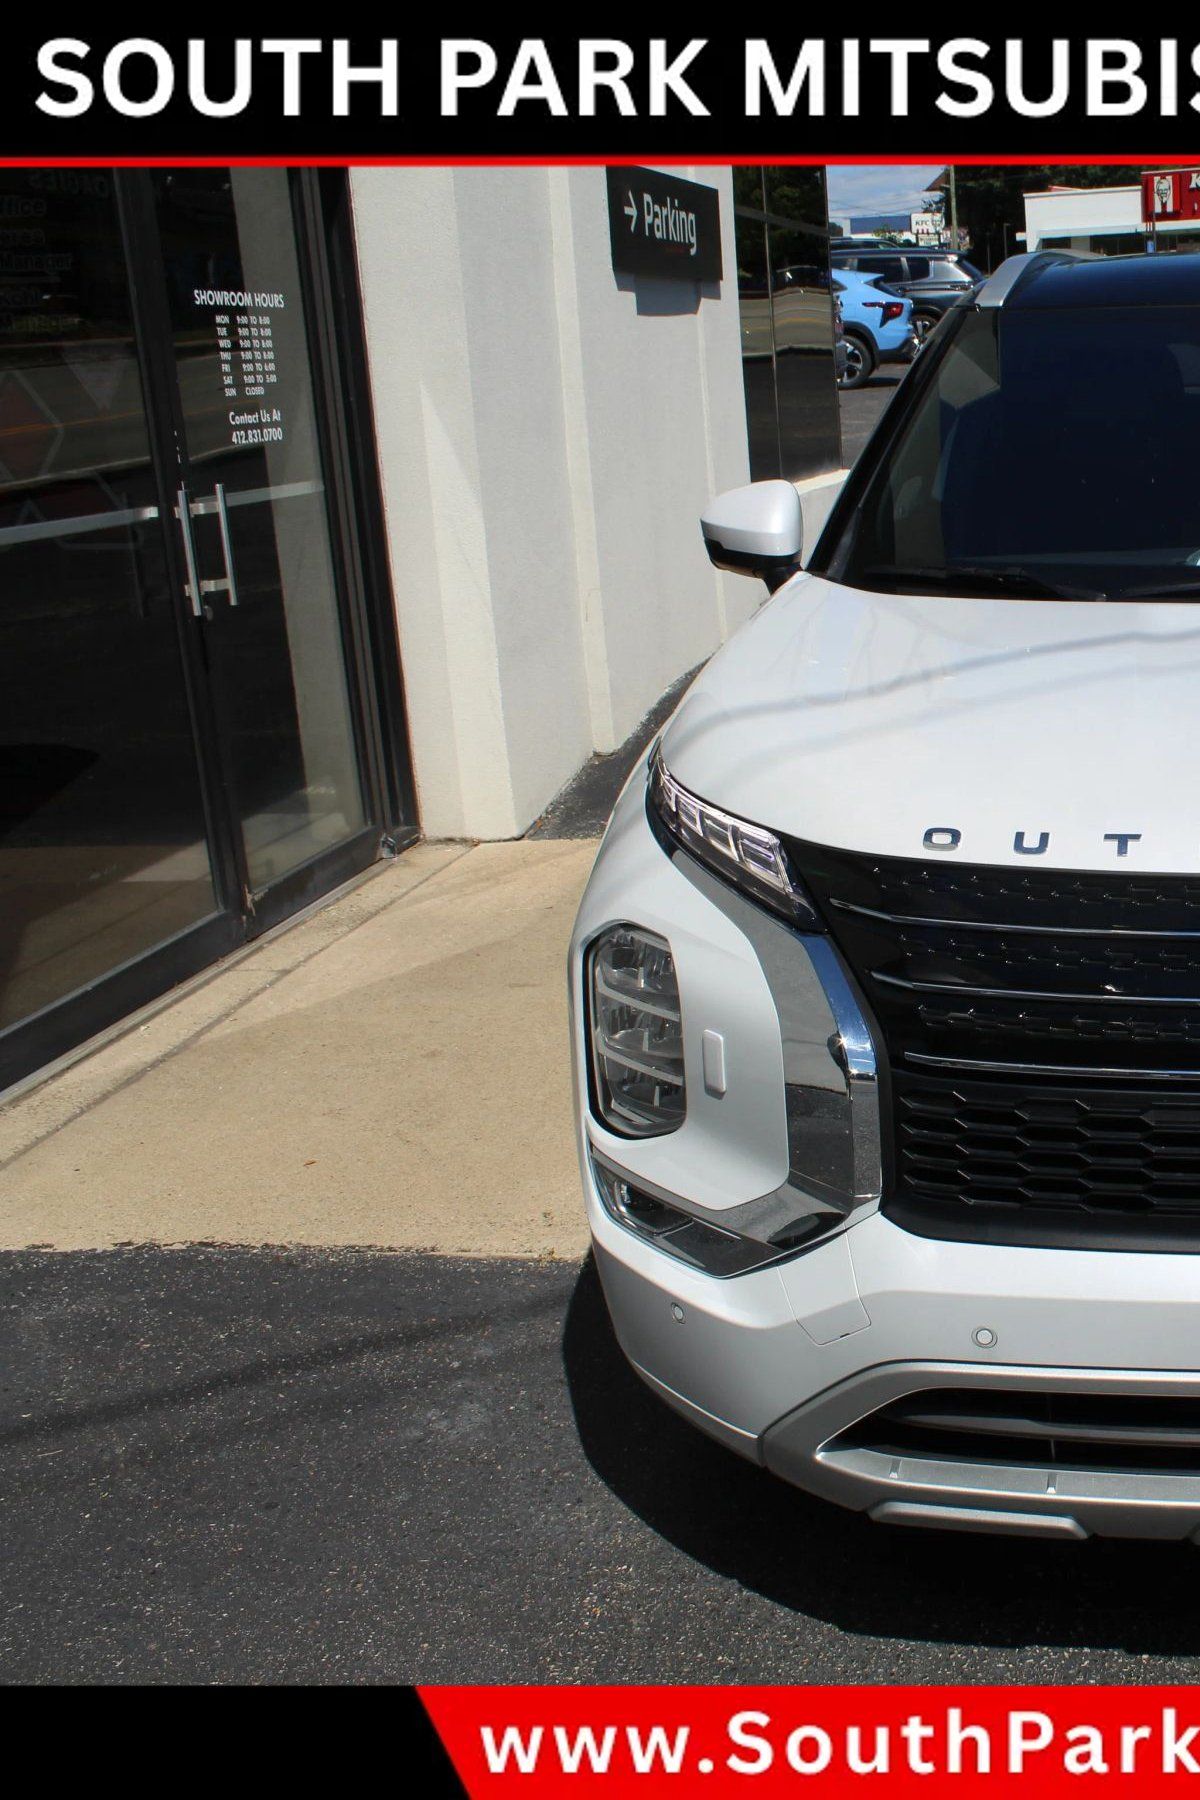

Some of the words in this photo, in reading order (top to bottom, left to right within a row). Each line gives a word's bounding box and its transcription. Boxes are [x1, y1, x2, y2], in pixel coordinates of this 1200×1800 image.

[643, 193, 697, 256] Parking
[194, 289, 253, 307] SHOWROOM
[254, 293, 285, 308] HOURS
[215, 315, 229, 324] MON
[236, 316, 248, 324] 9:00
[249, 316, 257, 324] TO
[216, 327, 227, 336] TUE
[238, 327, 249, 336] 9:00
[250, 327, 258, 336] TO
[218, 340, 231, 348] WED
[239, 340, 251, 348] 9:00
[252, 340, 260, 348] TO
[220, 352, 231, 360] THU
[241, 352, 252, 360] 9:00
[254, 351, 261, 360] TO
[221, 364, 231, 372] FRI
[242, 363, 253, 371] 9:00
[255, 363, 263, 371] TO
[223, 376, 233, 384] SAT
[243, 375, 255, 384] 9:00
[256, 375, 264, 383] TO
[225, 388, 237, 397] SUN
[245, 387, 265, 396] CLOSED
[229, 411, 259, 425] Contact
[260, 409, 270, 422] Us
[272, 408, 281, 422] At
[231, 427, 283, 444] 412.831.0700
